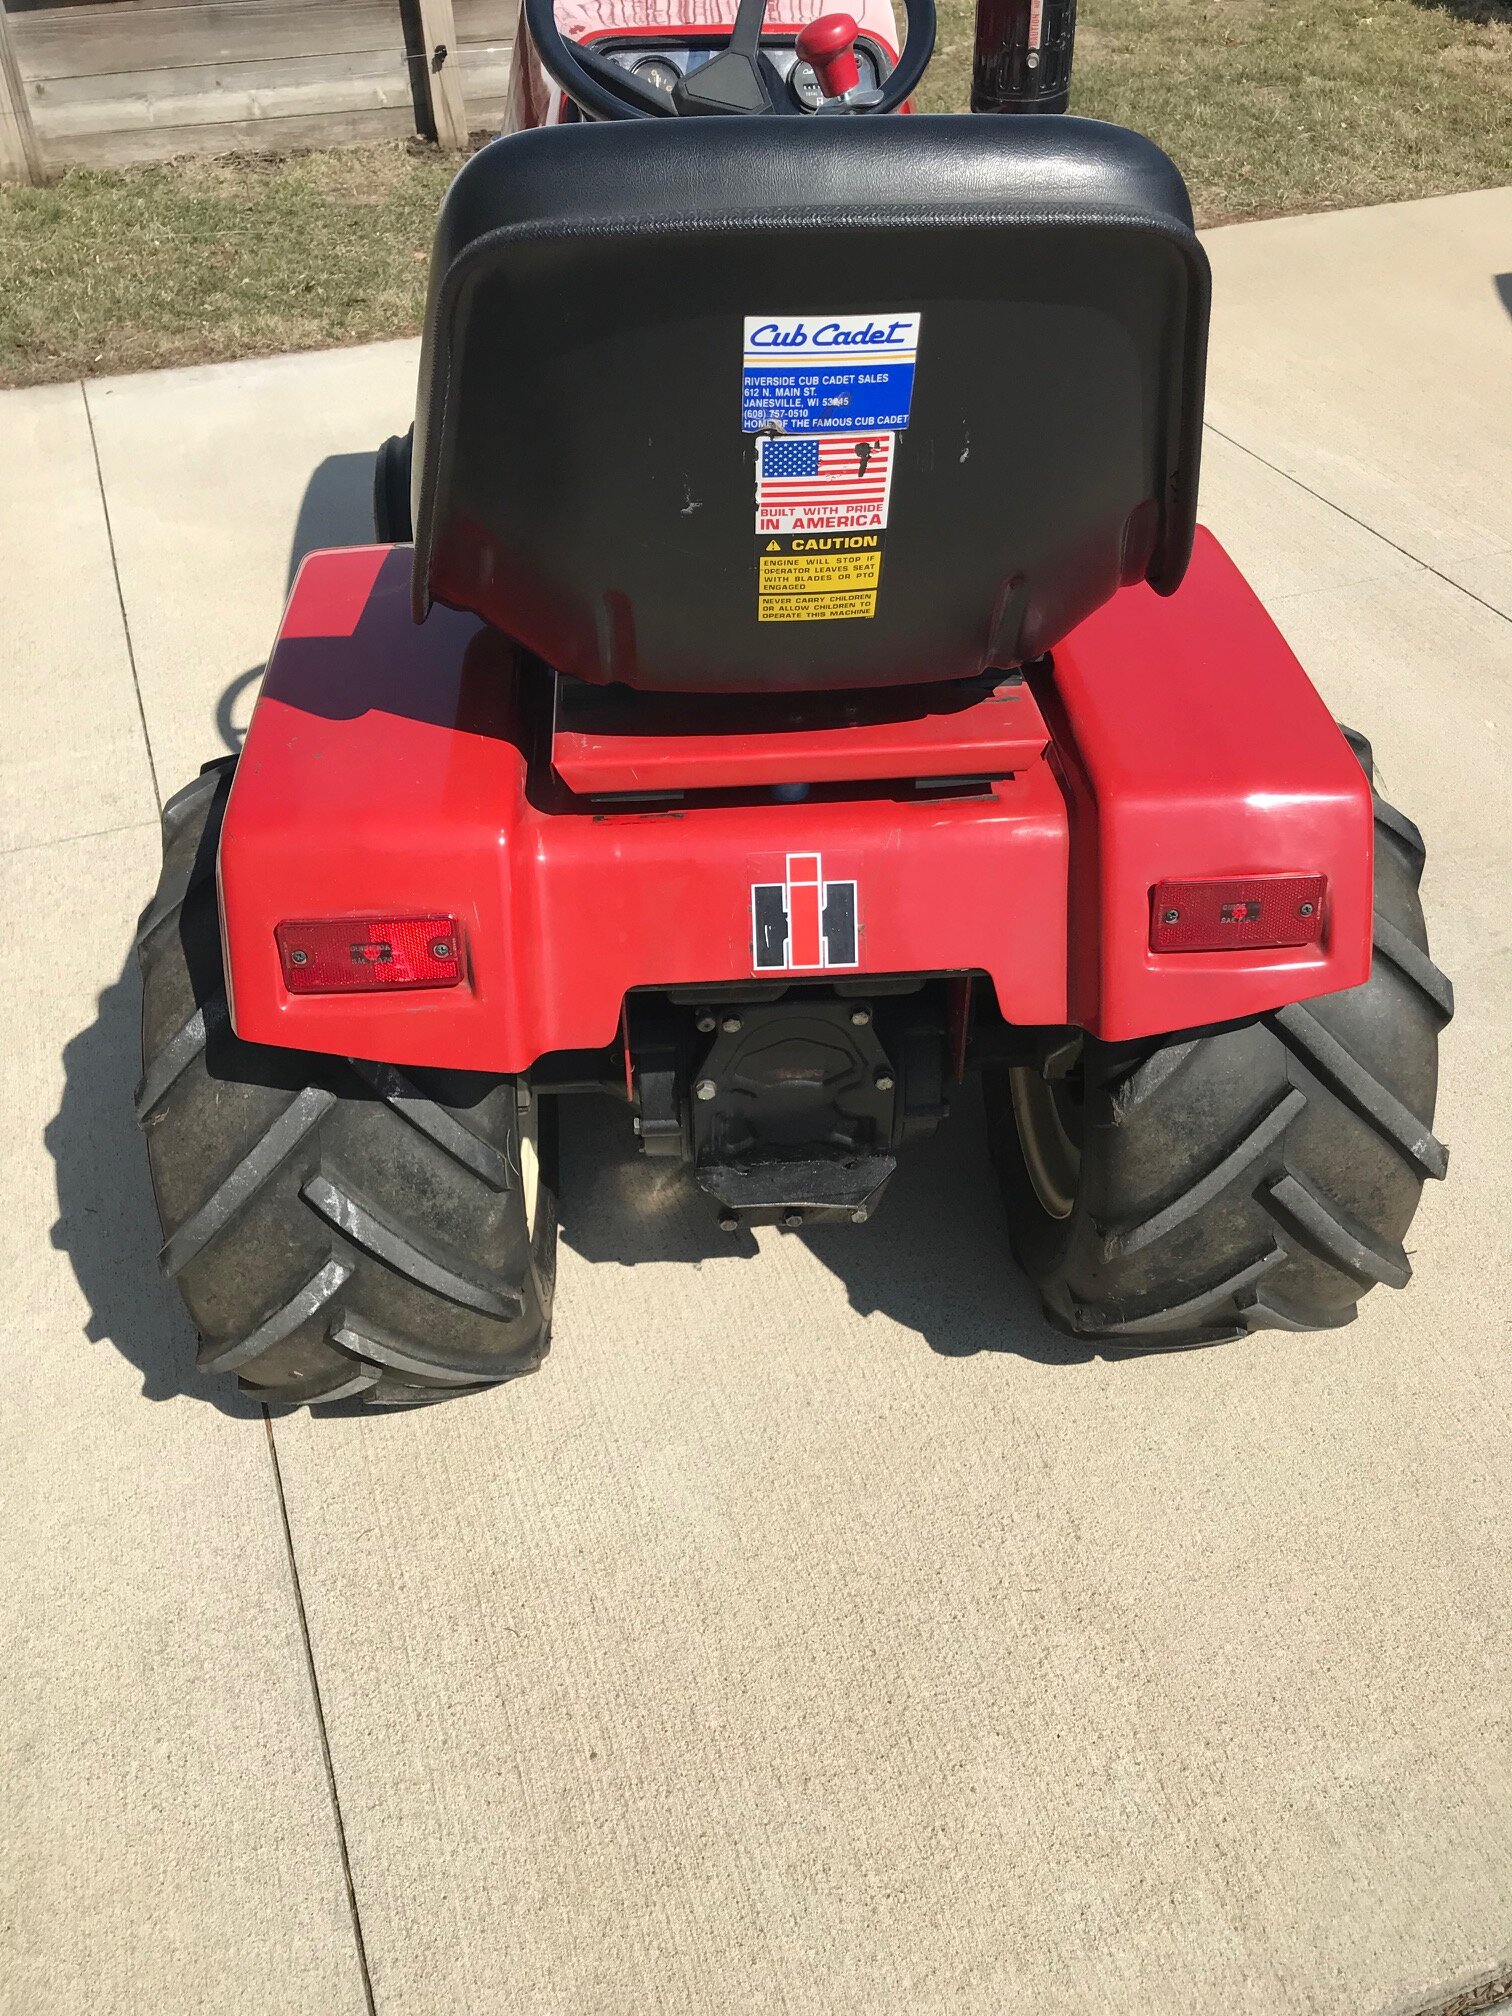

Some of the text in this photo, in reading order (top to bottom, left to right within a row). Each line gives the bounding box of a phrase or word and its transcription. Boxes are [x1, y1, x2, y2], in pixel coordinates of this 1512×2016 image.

[750, 322, 912, 346] Cub Cadet
[744, 374, 889, 386] RIVERSIDE CUB CADET SALES
[744, 387, 817, 397] 612 N. MAIN ST.
[744, 398, 849, 408] JANESVILLE, WI 5345
[744, 409, 808, 419] (608) 757-0510
[744, 420, 772, 428] HOME
[791, 419, 809, 428] THE
[812, 418, 852, 427] FAMOUS
[855, 416, 874, 425] CUB
[877, 414, 909, 424] CADET
[760, 504, 883, 517] BUILT WITH PRIDE
[760, 514, 881, 530] IN AMERICA
[792, 536, 877, 551] CAUTION
[830, 594, 872, 602] CHILDREN
[814, 602, 856, 610] CHILDREN
[830, 608, 871, 617] MACHINE
